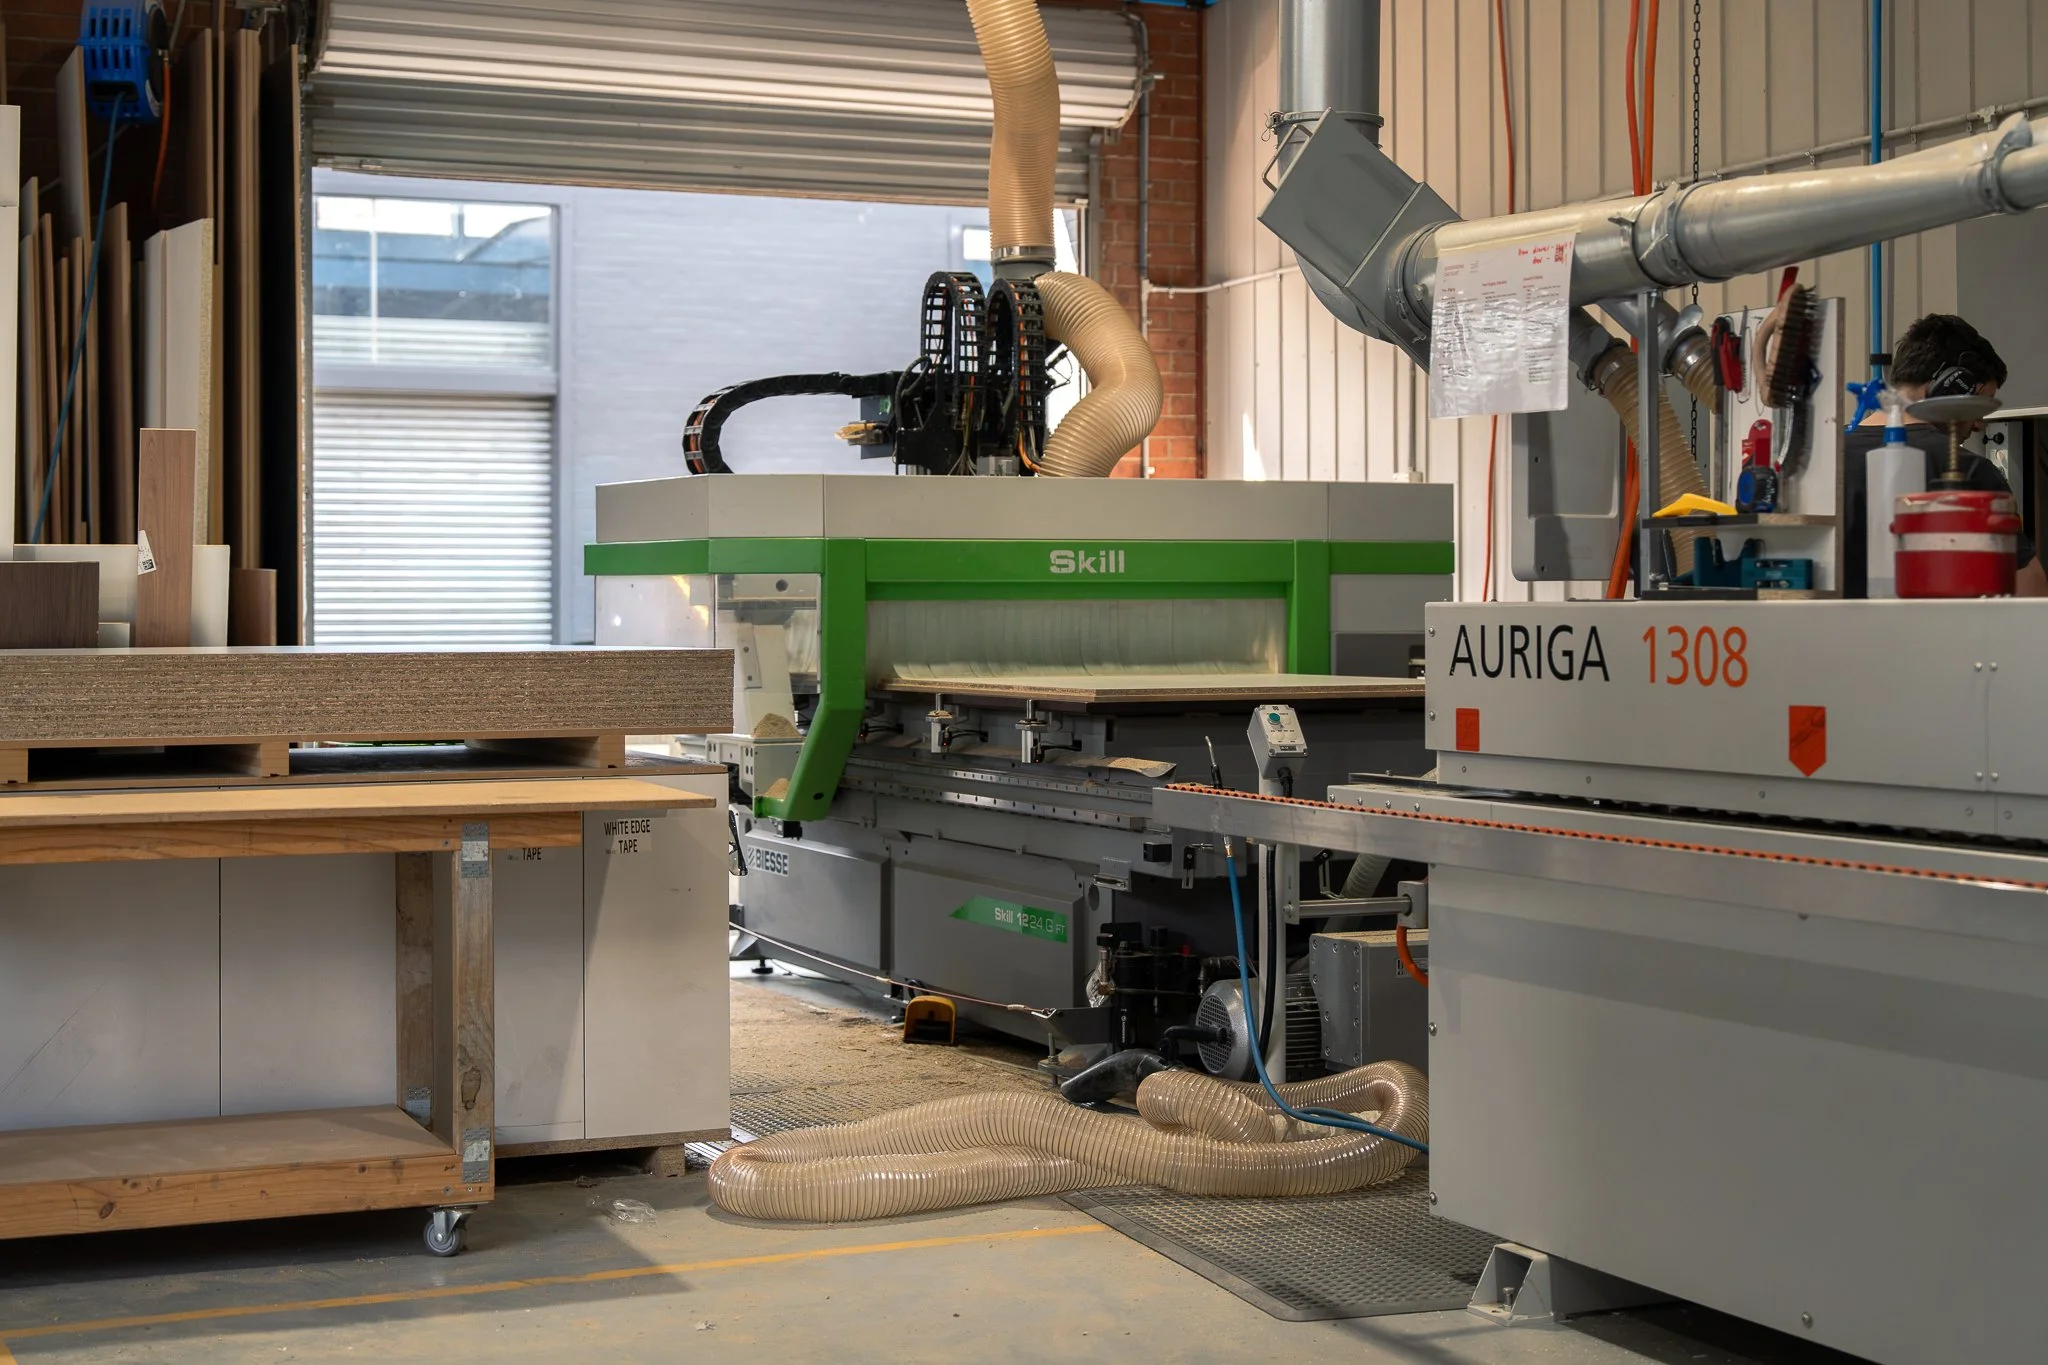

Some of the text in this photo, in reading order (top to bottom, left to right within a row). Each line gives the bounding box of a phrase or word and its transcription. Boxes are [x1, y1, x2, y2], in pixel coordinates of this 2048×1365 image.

[1050, 550, 1125, 574] Skill
[1449, 624, 1748, 688] AURIGA 1308
[603, 819, 651, 836] WHITE EDGE
[522, 847, 542, 861] TAPE
[618, 839, 638, 854] TAPE
[755, 848, 789, 875] BIESSE
[994, 907, 1014, 924] Skill
[1016, 912, 1043, 930] 1224
